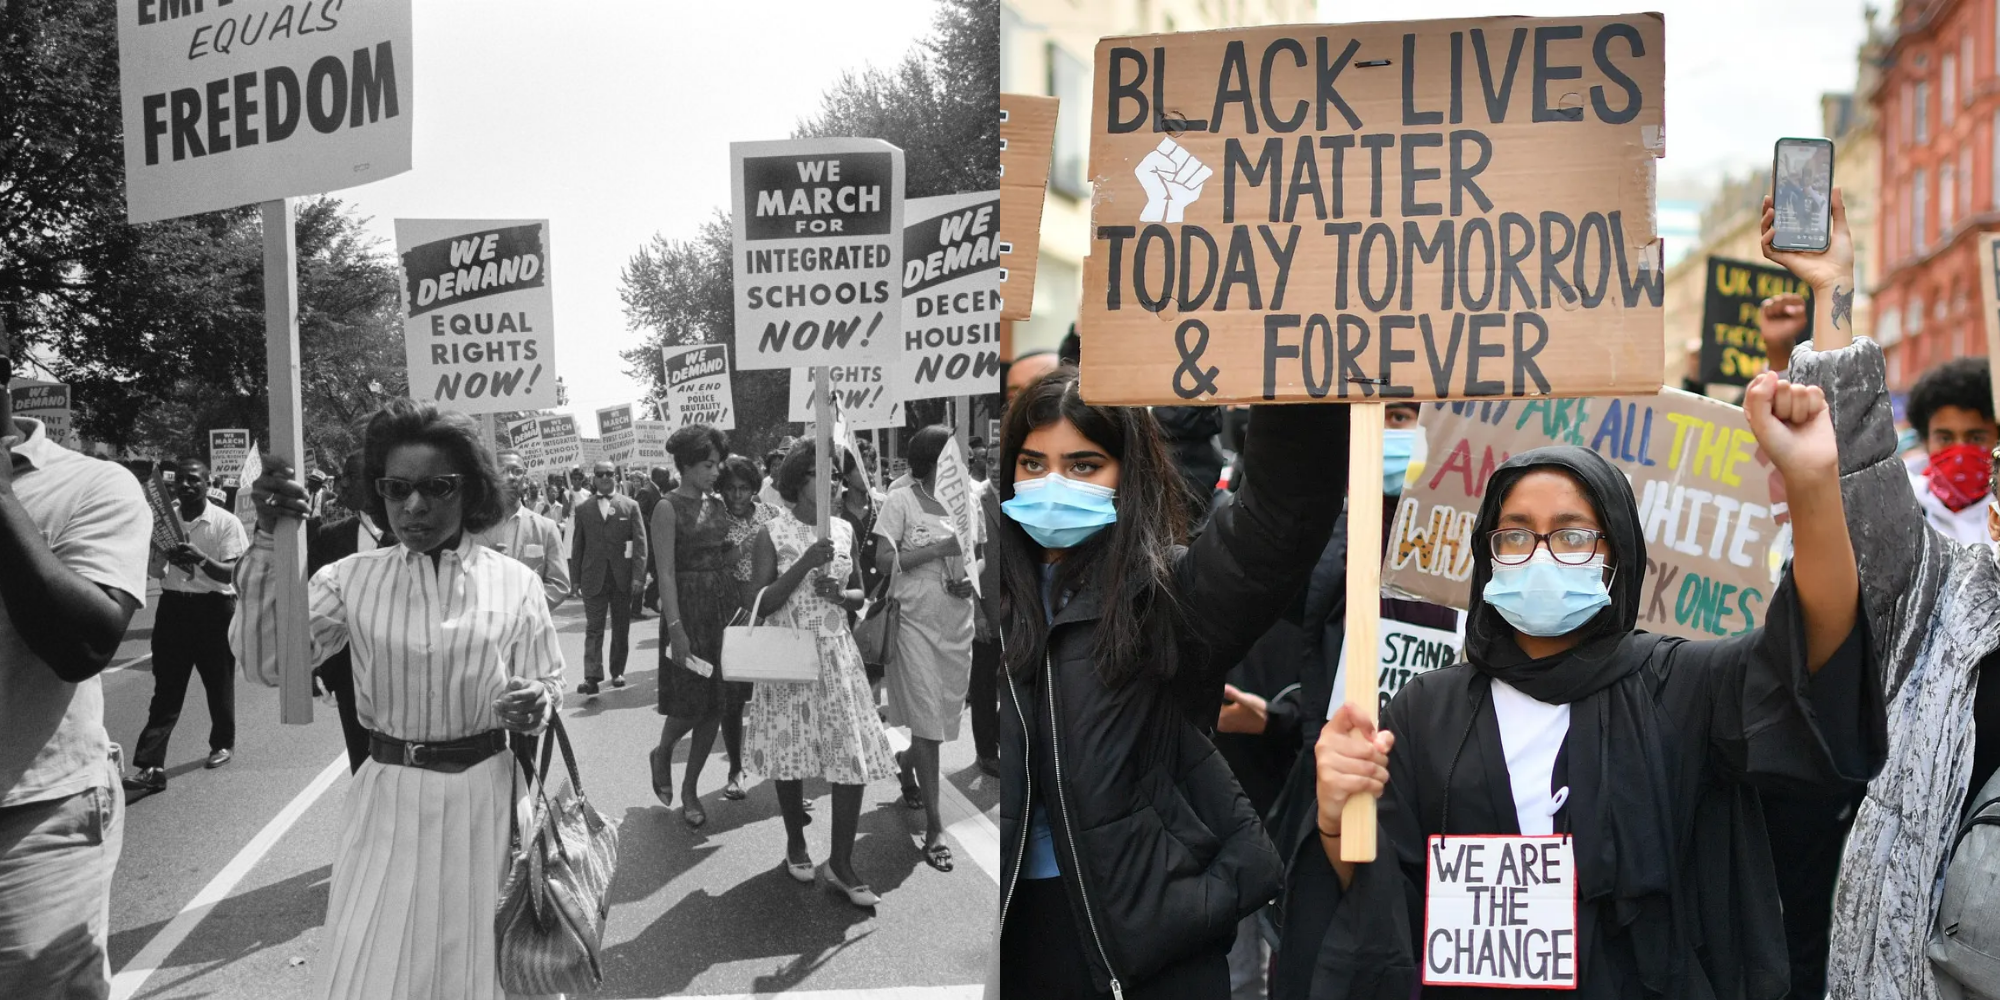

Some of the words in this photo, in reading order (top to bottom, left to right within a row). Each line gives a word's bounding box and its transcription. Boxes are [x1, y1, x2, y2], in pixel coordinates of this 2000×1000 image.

[188, 0, 343, 60] EQUALS
[1108, 38, 1363, 135] BLACK
[1402, 25, 1646, 125] LIVES
[143, 40, 400, 166] FREEDOM
[797, 160, 840, 183] WE
[1223, 131, 1494, 224] MATTER
[756, 185, 880, 217] MARCH
[796, 219, 843, 233] FOR
[939, 205, 993, 246] WE
[449, 234, 499, 268] WE
[746, 244, 891, 274] INTEGRATED
[1098, 225, 1302, 312] TODAY
[1323, 211, 1664, 312] TOMORROW
[417, 253, 539, 307] DEMAND
[747, 280, 889, 310] SCHOOLS
[431, 312, 533, 336] EQUAL
[758, 311, 884, 353] NOW!
[431, 339, 538, 365] RIGHTS
[686, 350, 706, 366] WE
[1173, 319, 1219, 400] &
[1262, 311, 1551, 400] FOREVER
[434, 364, 543, 401] NOW!
[672, 358, 723, 384] DEMAND
[808, 366, 882, 382] RGHTS
[29, 387, 50, 398] WE
[677, 384, 695, 393] AN
[698, 382, 721, 391] END
[687, 394, 715, 404] POLICE
[15, 396, 66, 410] DEMAND
[680, 402, 720, 412] BRUTALITY
[681, 407, 728, 426] NOW!
[543, 423, 572, 434] MARCH
[543, 436, 577, 447] INTEGRATED
[1591, 398, 1656, 467] ALL
[1667, 412, 1757, 487] THE
[545, 444, 579, 455] SCHOOLS
[550, 452, 579, 465] NOW!
[609, 447, 635, 462] NOW!
[937, 454, 969, 536] FREEDOM
[1675, 573, 1763, 636] ONES
[1382, 633, 1456, 668] STAND
[1432, 844, 1485, 883] WE
[1496, 843, 1560, 886] ARE
[1466, 886, 1528, 926] THE
[1428, 928, 1573, 981] CHANGE
